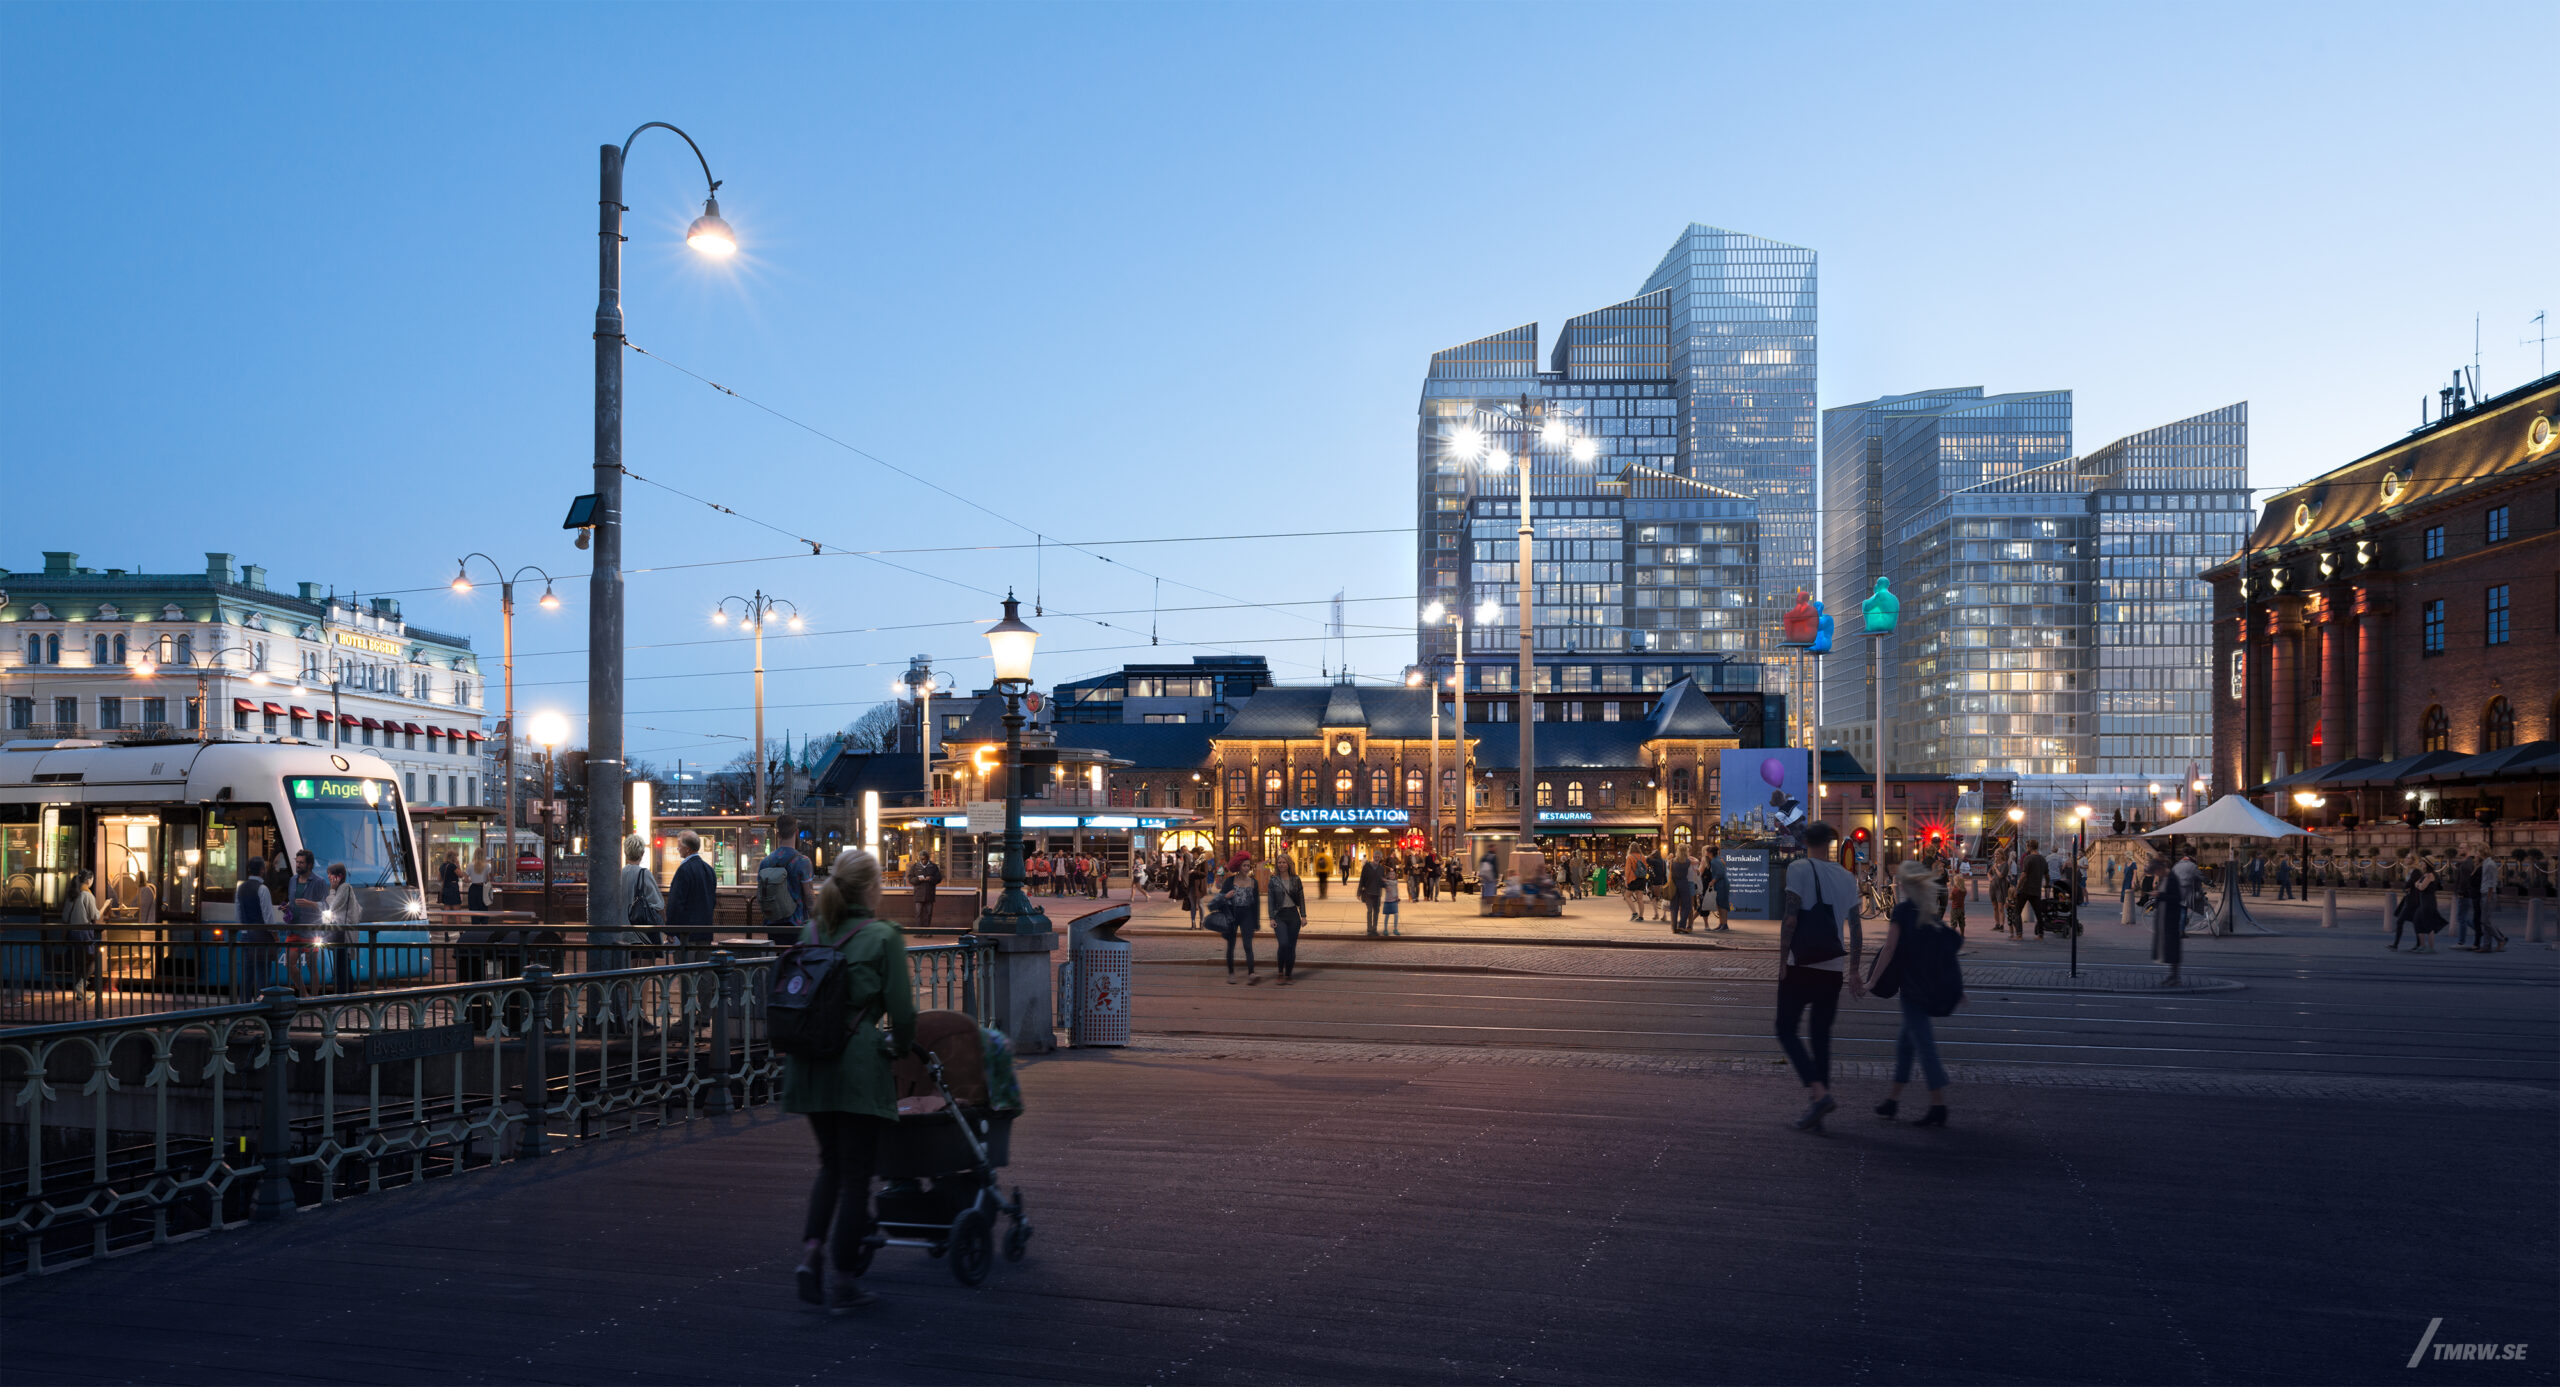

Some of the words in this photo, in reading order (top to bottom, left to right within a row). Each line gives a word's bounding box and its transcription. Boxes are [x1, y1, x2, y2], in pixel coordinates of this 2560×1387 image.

[339, 633, 368, 650] HOTEL
[368, 639, 400, 656] EGGERS
[296, 780, 309, 797] 4
[1280, 809, 1409, 822] CENTRALSTATION
[1539, 812, 1592, 820] RESTAURANG
[1726, 854, 1762, 862] Barnkalas!
